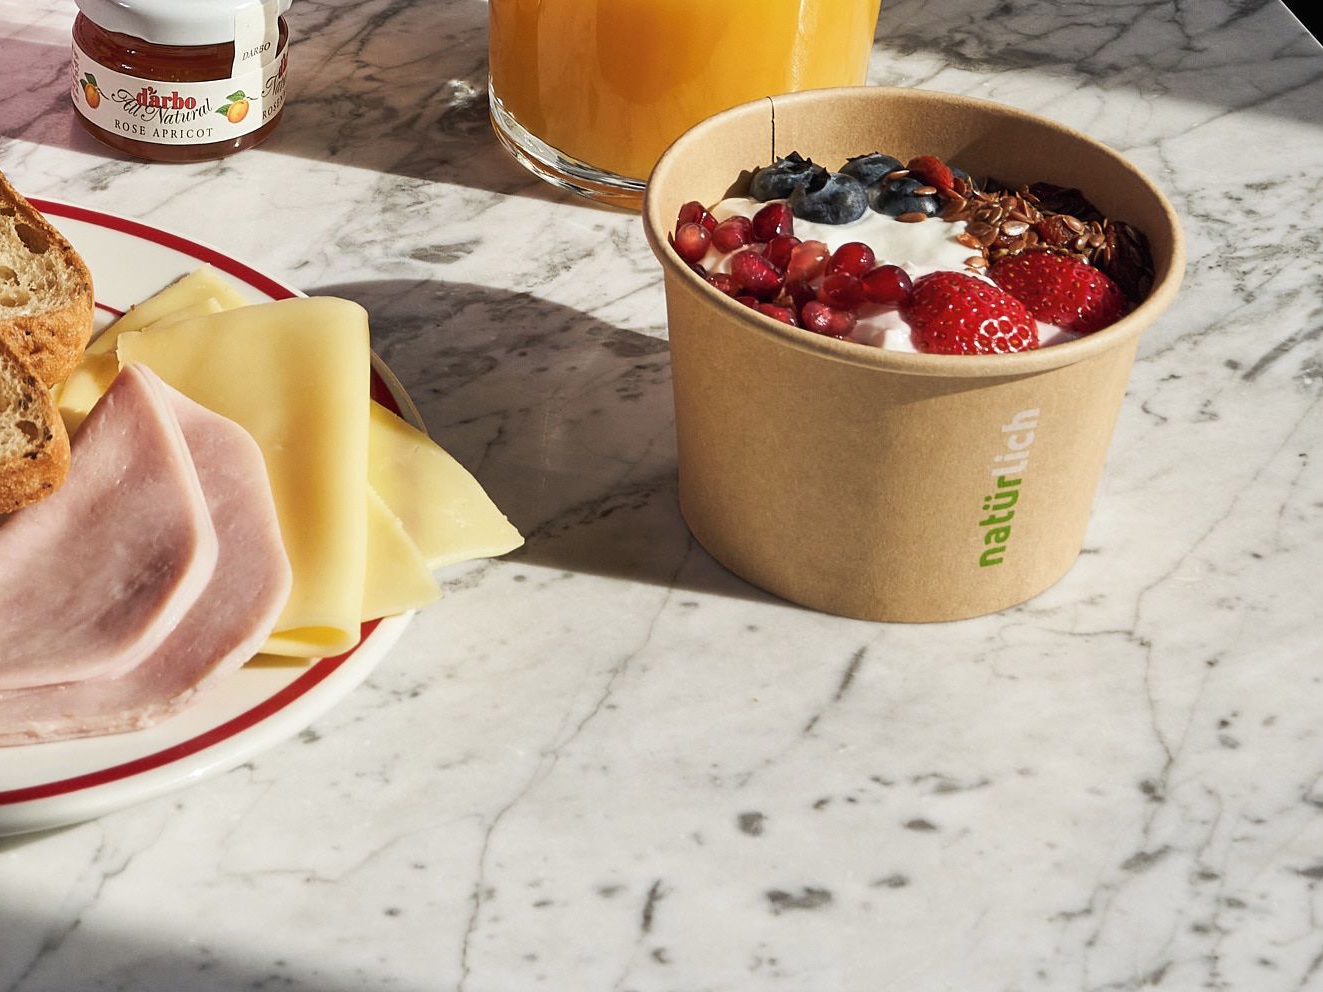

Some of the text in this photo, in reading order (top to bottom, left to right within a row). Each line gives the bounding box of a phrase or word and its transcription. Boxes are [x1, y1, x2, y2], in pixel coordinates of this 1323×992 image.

[242, 41, 271, 61] DARBO
[140, 97, 213, 125] Natural
[114, 119, 213, 139] ROSE APRICOT
